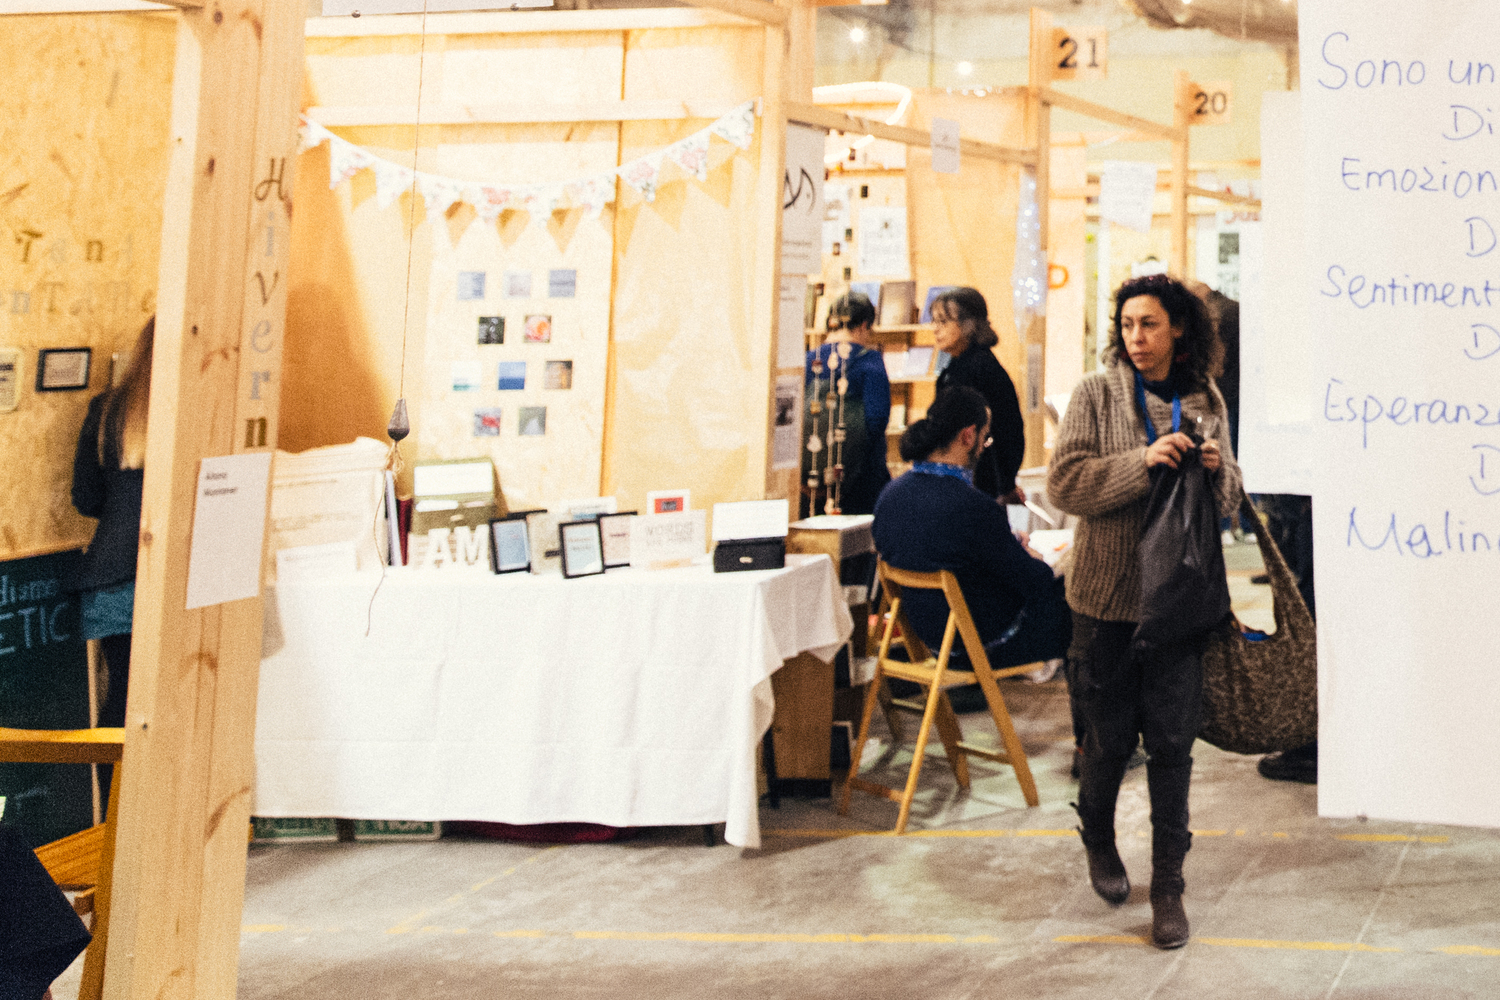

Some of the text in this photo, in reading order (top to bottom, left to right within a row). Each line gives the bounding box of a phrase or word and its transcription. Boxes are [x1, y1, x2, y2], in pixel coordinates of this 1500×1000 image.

[1057, 37, 1100, 70] 21
[1318, 32, 1426, 89] Sono
[1194, 91, 1228, 116] 20
[1442, 105, 1494, 140] Di
[244, 157, 286, 448] Hivern
